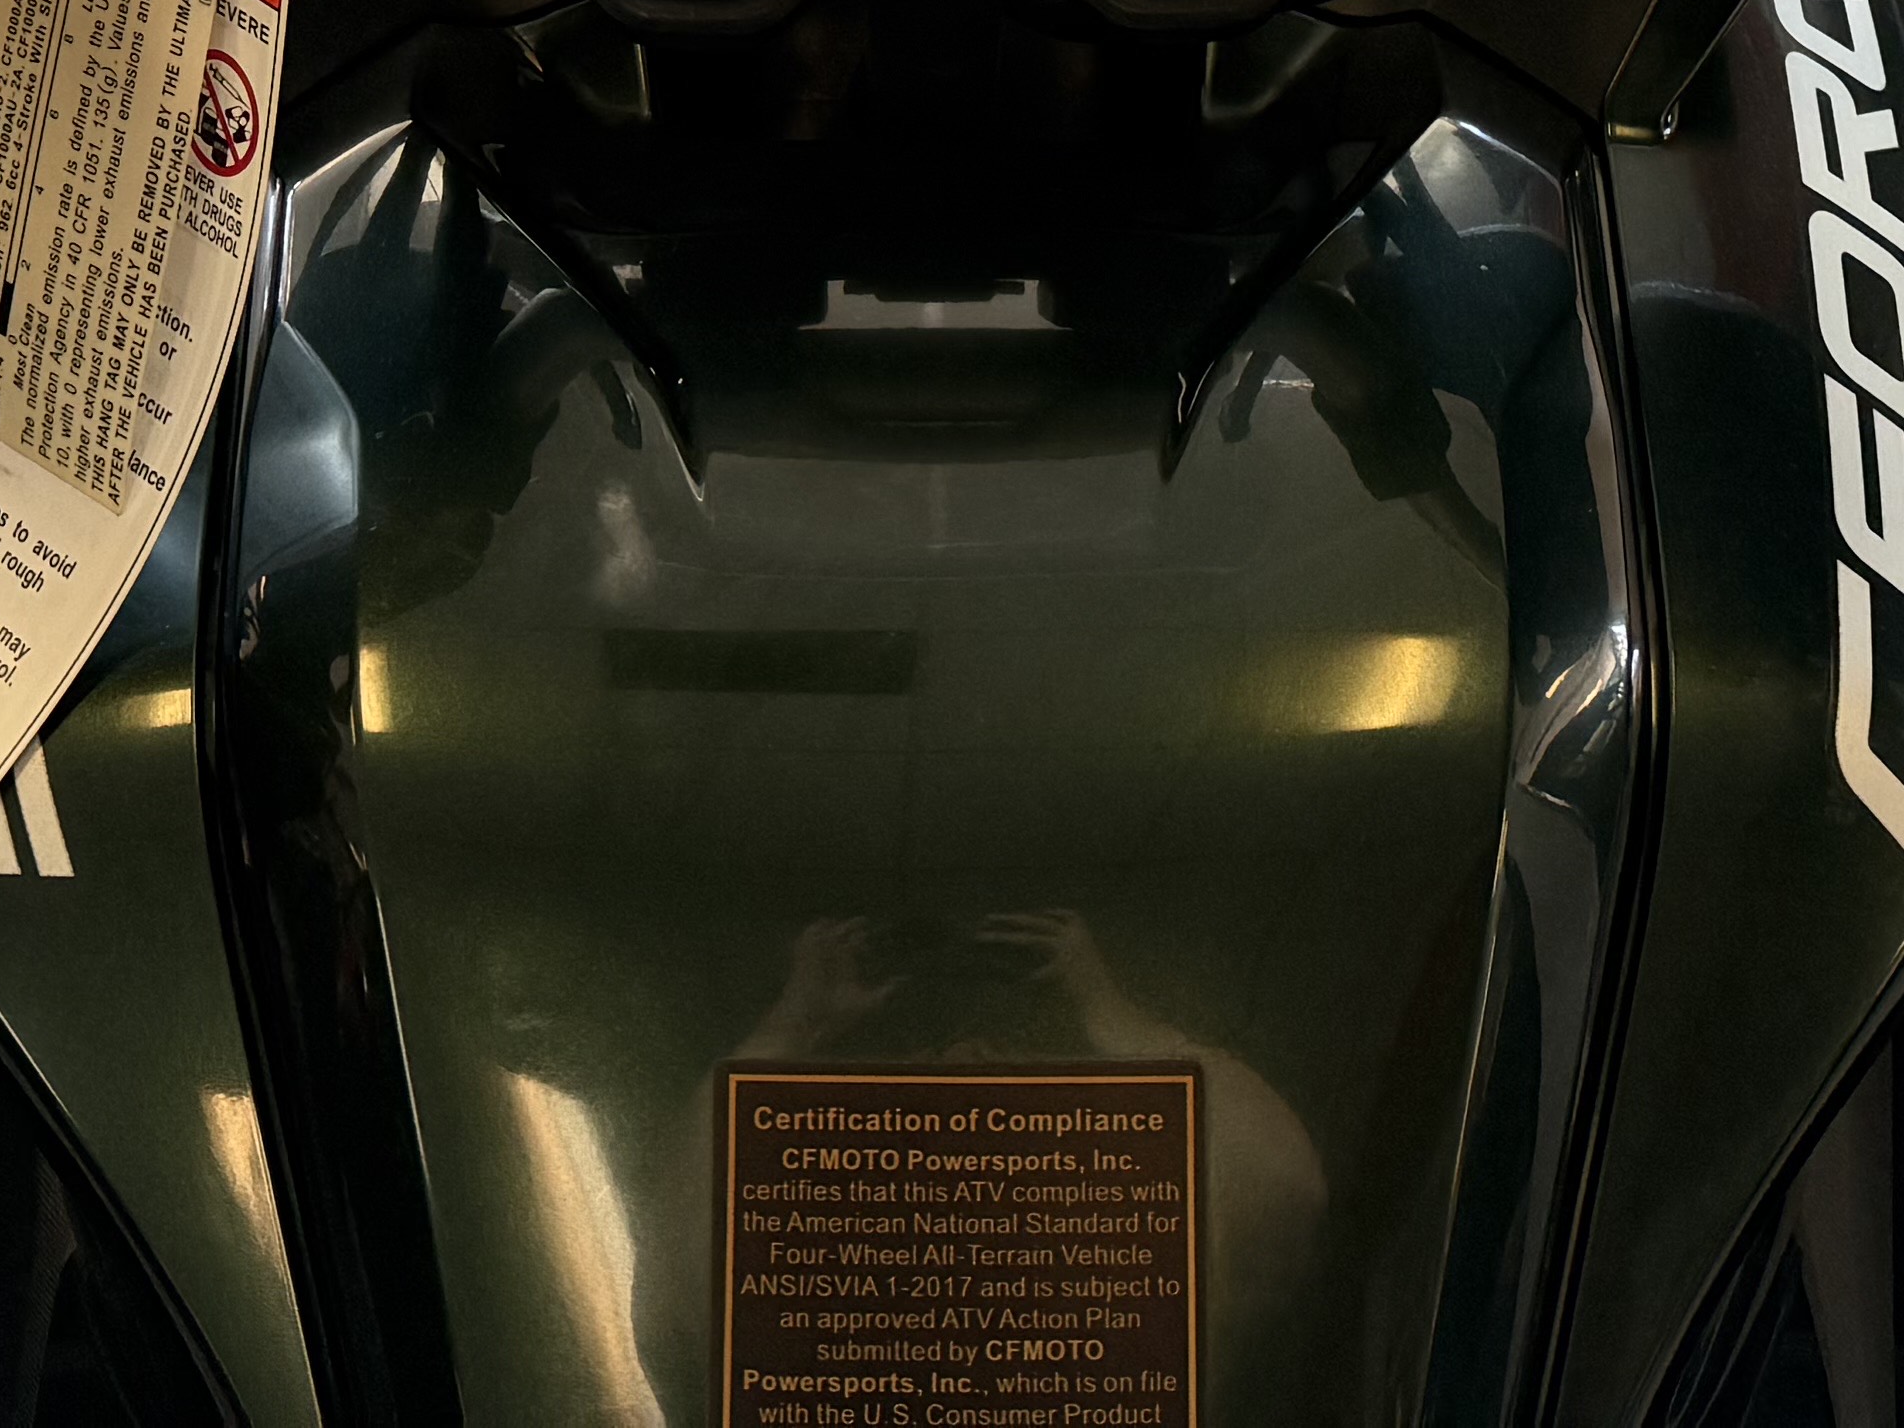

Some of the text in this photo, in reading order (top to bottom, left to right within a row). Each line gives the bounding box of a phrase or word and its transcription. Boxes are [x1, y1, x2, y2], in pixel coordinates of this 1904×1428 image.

[216, 0, 270, 46] EVERE
[12, 520, 29, 543] to
[32, 540, 77, 580] avoid
[754, 1106, 1164, 1138] Certification of Compliance
[782, 1147, 1141, 1176] CFMOTO Powersports, Inc.
[742, 1179, 1180, 1207] certifies that this ATV complies with
[743, 1210, 1180, 1234] the American National Standard for
[770, 1241, 1153, 1266] Four-Wheel All-Terrain Vehicle
[740, 1274, 1181, 1303] ANSI/SVIA 1-2017 and is subject to
[779, 1307, 1141, 1334] an approved ATV Action Plan
[817, 1339, 1104, 1367] submitted by CFMOTO
[743, 1369, 1177, 1398] Powersports, Inc., which is on file
[758, 1402, 1161, 1426] with the U.S. Consumer Product
